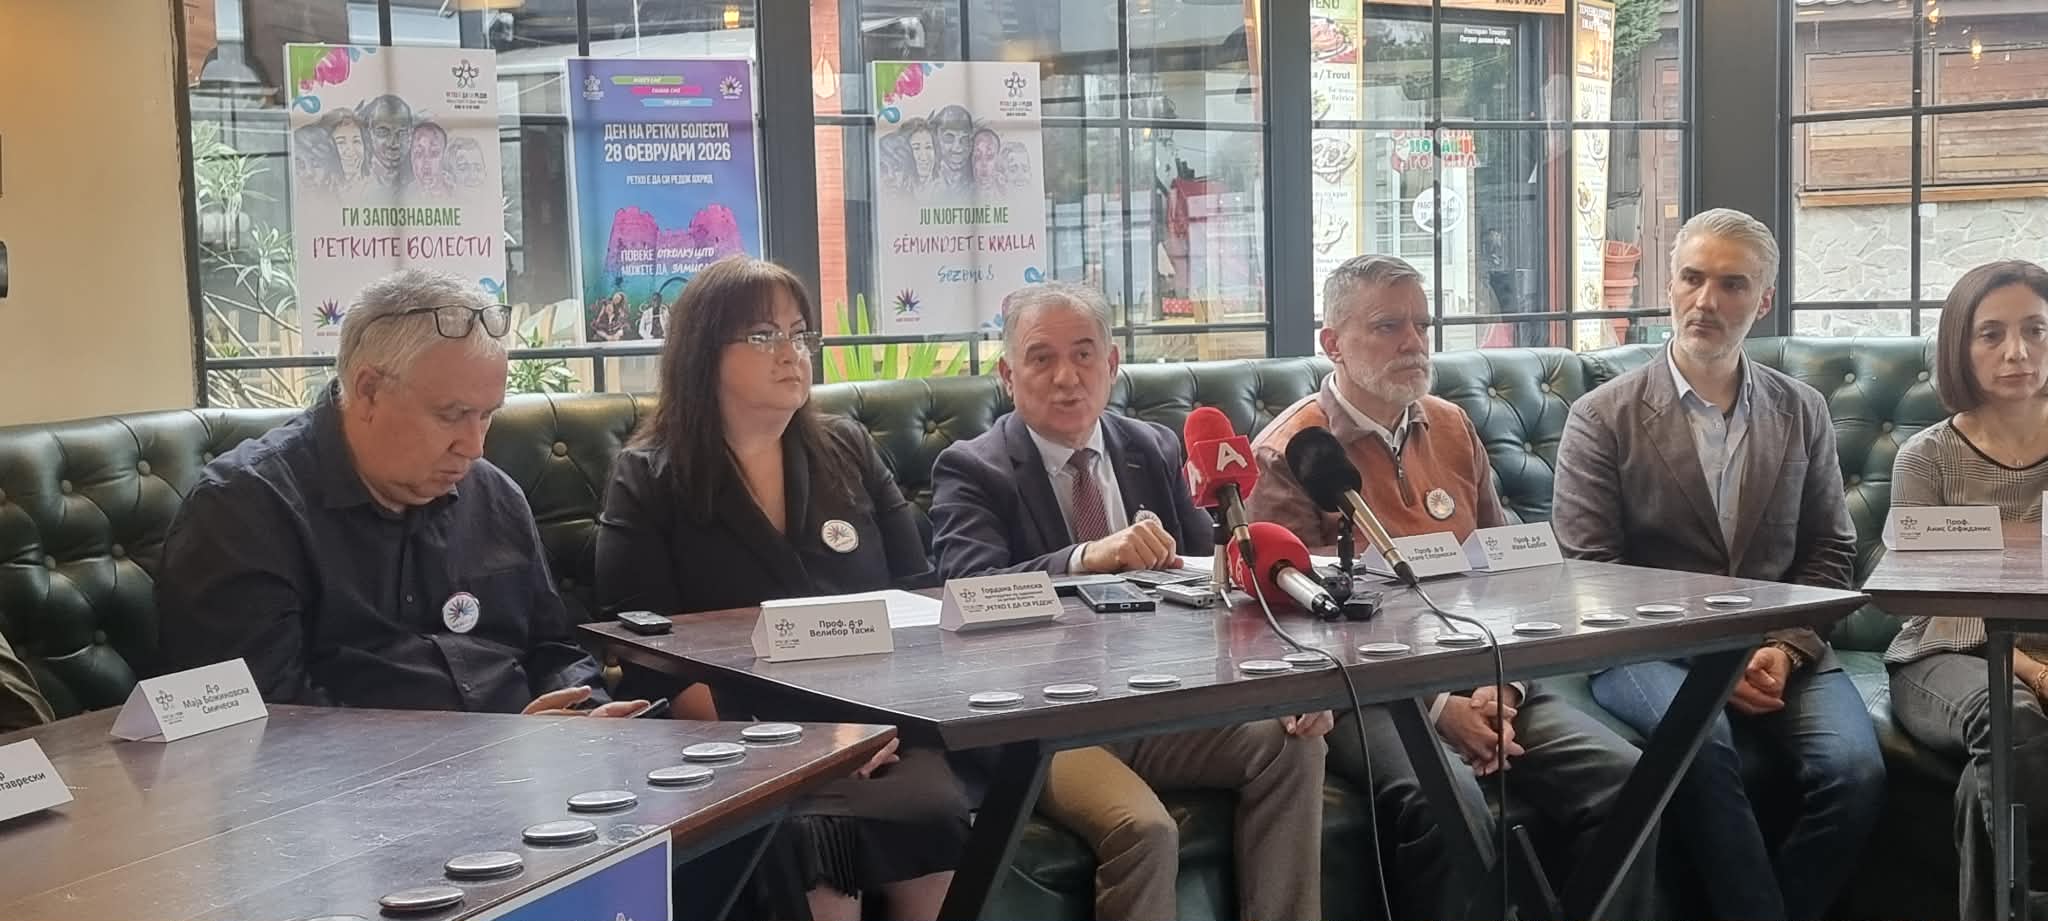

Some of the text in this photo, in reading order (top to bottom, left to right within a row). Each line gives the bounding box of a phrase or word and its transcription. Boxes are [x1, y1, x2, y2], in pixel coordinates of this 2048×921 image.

[1326, 70, 1350, 79] Trout
[604, 123, 729, 141] ДЕН НА РЕТКИ БОЛЕСТИ
[605, 142, 731, 162] 28 ФЕВРУАРИ 2026
[342, 207, 461, 226] ГИ ЗАПОЗНАВАМЕ
[920, 204, 1009, 225] JU NJOFTOJMË ME
[313, 235, 491, 259] РЕТКИТЕ БОЛЕСТИ
[893, 234, 974, 254] SËMUNDJET
[978, 236, 984, 251] E
[656, 263, 668, 275] ДА
[1217, 442, 1248, 472] A
[1946, 518, 1968, 526] Проф.
[809, 627, 848, 638] Велибор
[819, 618, 863, 629] Проф. д-р
[182, 687, 250, 709] Маја Божиновска
[0, 772, 46, 791] таврески
